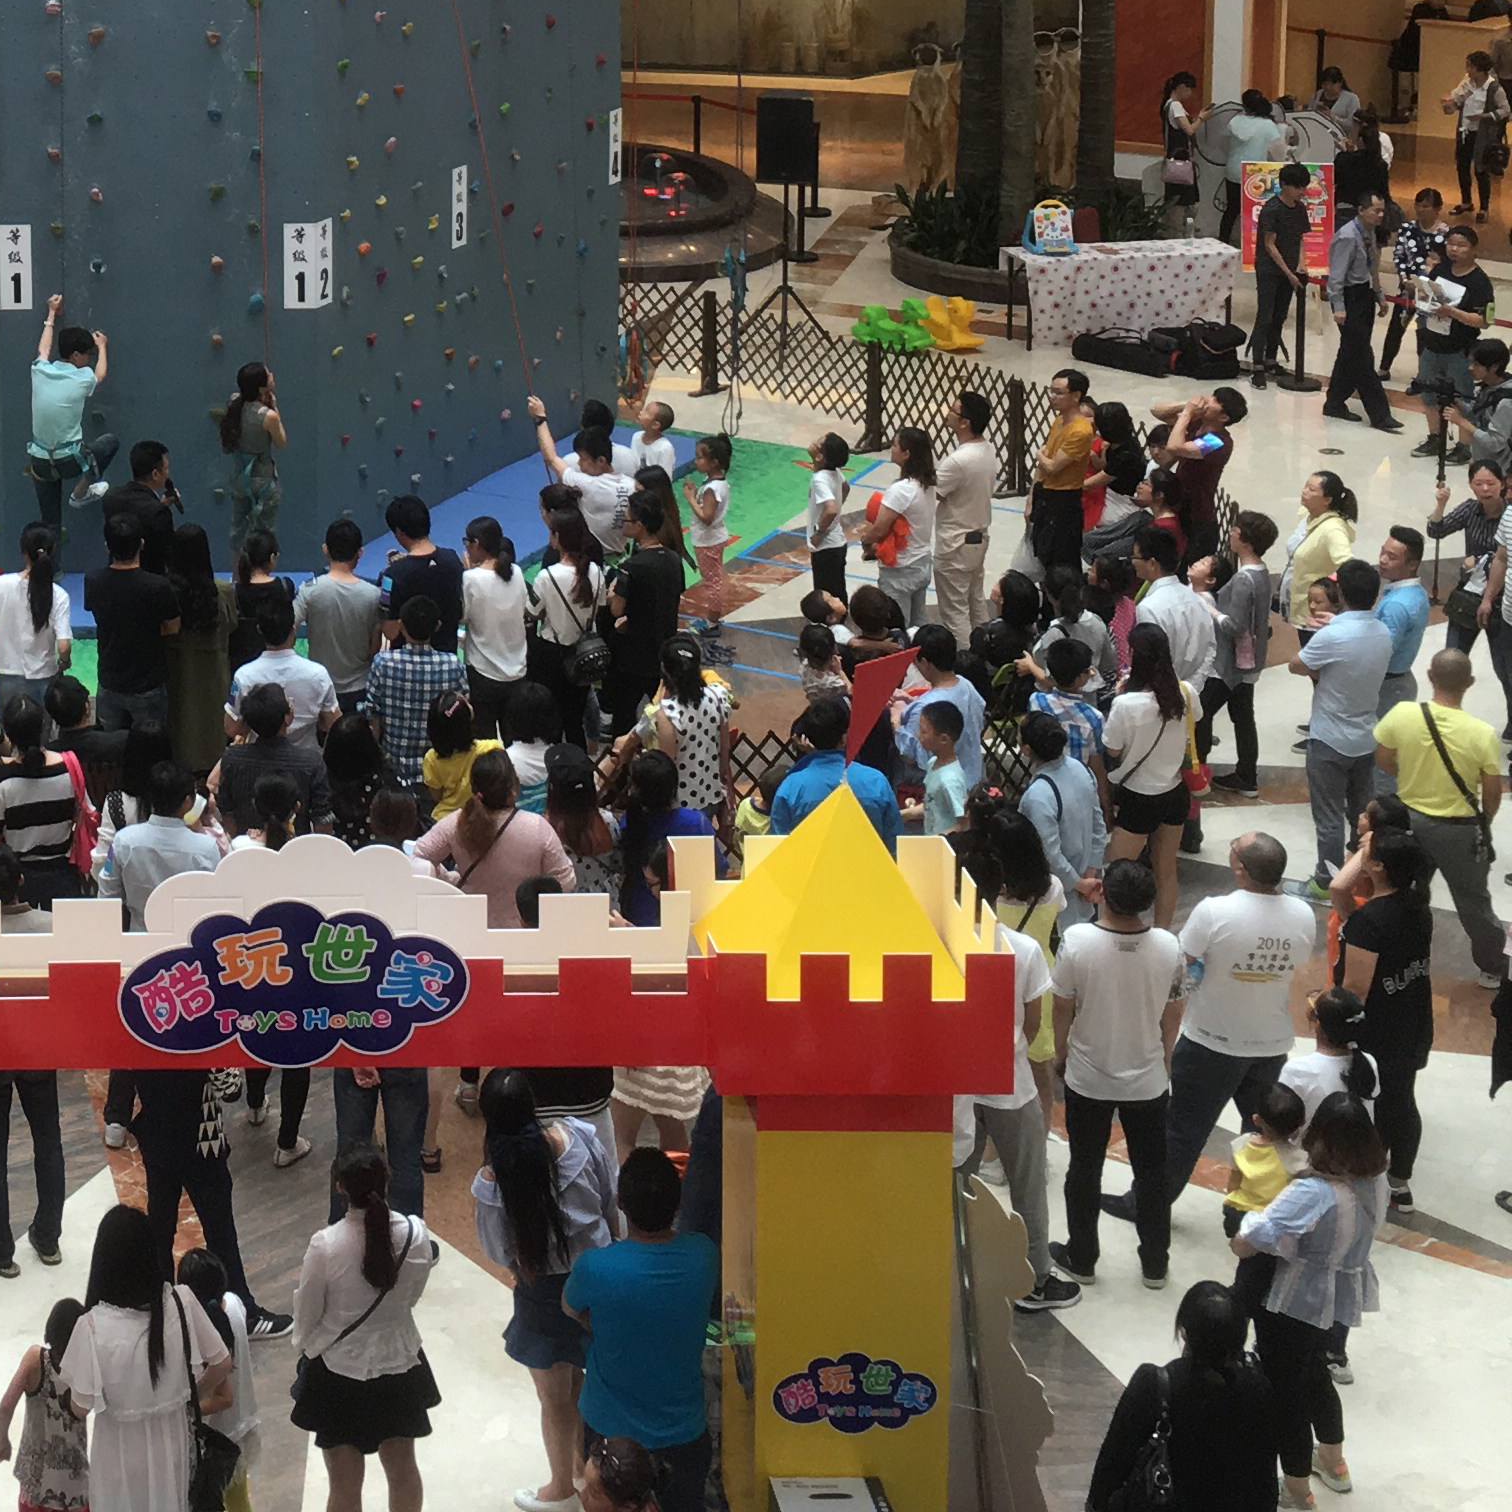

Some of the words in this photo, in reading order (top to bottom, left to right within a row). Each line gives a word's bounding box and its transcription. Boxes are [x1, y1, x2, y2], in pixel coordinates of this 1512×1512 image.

[612, 150, 619, 178] 4
[456, 211, 464, 241] 3
[11, 273, 21, 303] 1
[295, 271, 305, 302] 1
[320, 267, 328, 300] 2
[1256, 937, 1291, 951] 2016
[132, 922, 454, 1033] 酷玩世家
[214, 1009, 297, 1033] Toys
[303, 1007, 392, 1031] Home
[778, 1364, 931, 1415] 酷玩世家
